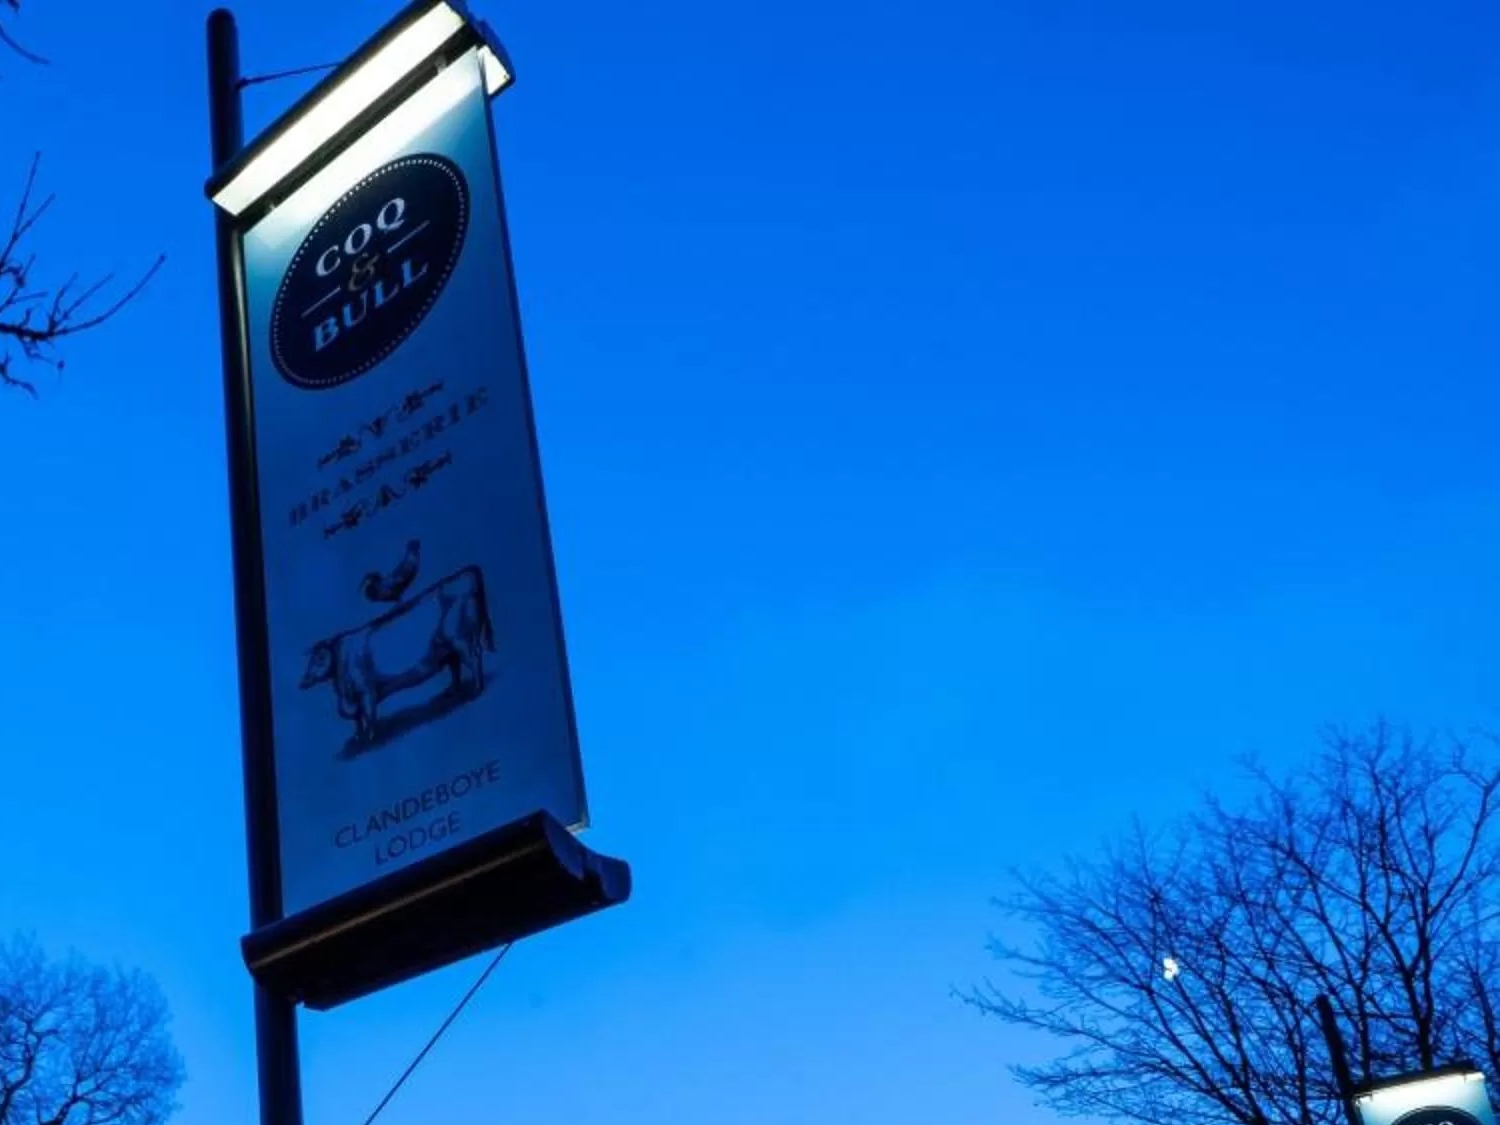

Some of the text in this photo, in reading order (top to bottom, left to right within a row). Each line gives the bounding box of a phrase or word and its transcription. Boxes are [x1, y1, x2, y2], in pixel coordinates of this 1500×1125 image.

[315, 197, 406, 278] COQ
[348, 253, 380, 291] &
[312, 258, 430, 351] BULL
[334, 758, 501, 849] CLANDEBOYE
[374, 809, 461, 865] LODGE
